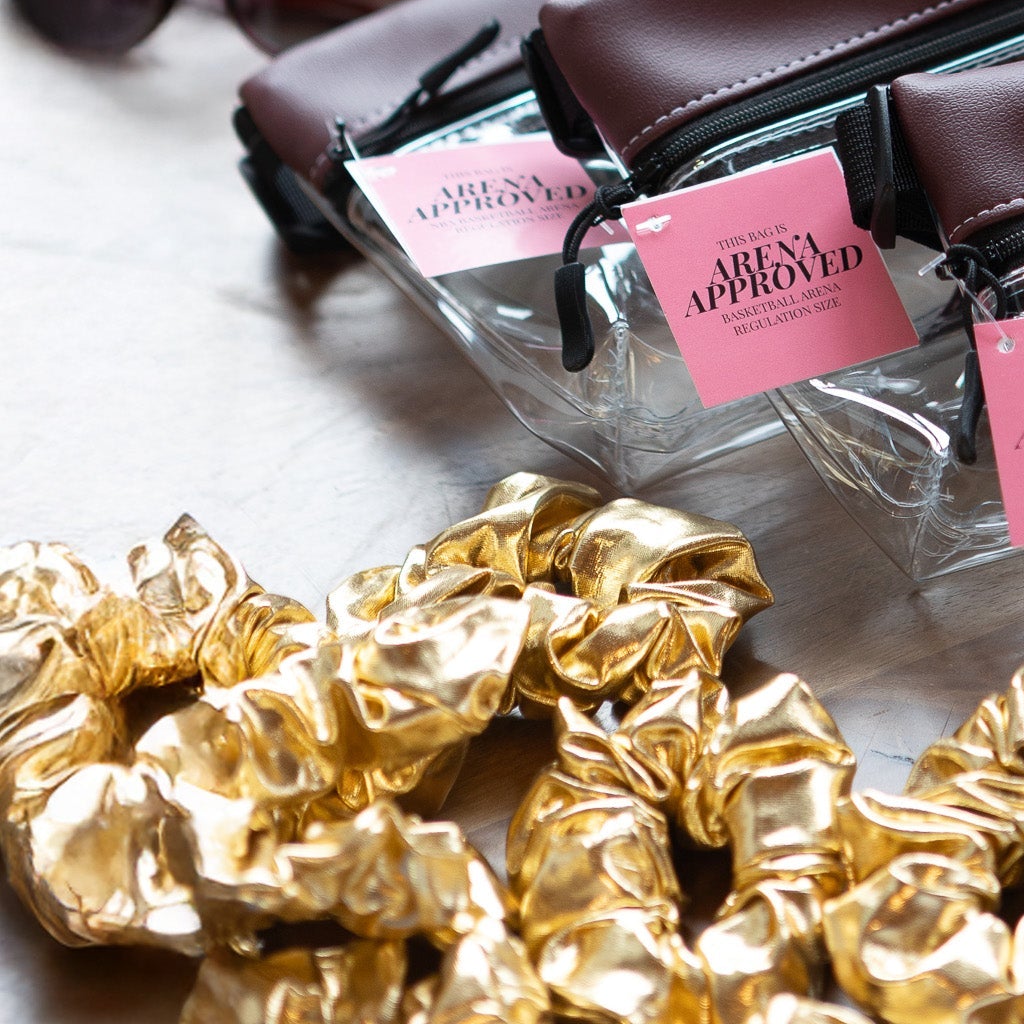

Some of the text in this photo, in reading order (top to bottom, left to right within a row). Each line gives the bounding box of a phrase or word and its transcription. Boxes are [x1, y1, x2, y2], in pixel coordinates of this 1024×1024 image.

[408, 185, 588, 224] APPROVED
[434, 175, 543, 202] ARENA
[716, 223, 788, 251] THIS BAG IS
[710, 232, 822, 285] ARENA
[685, 244, 863, 318] APPROVED
[721, 282, 842, 325] BASKETBALL ARENA
[733, 296, 842, 336] REGULATION SIZE
